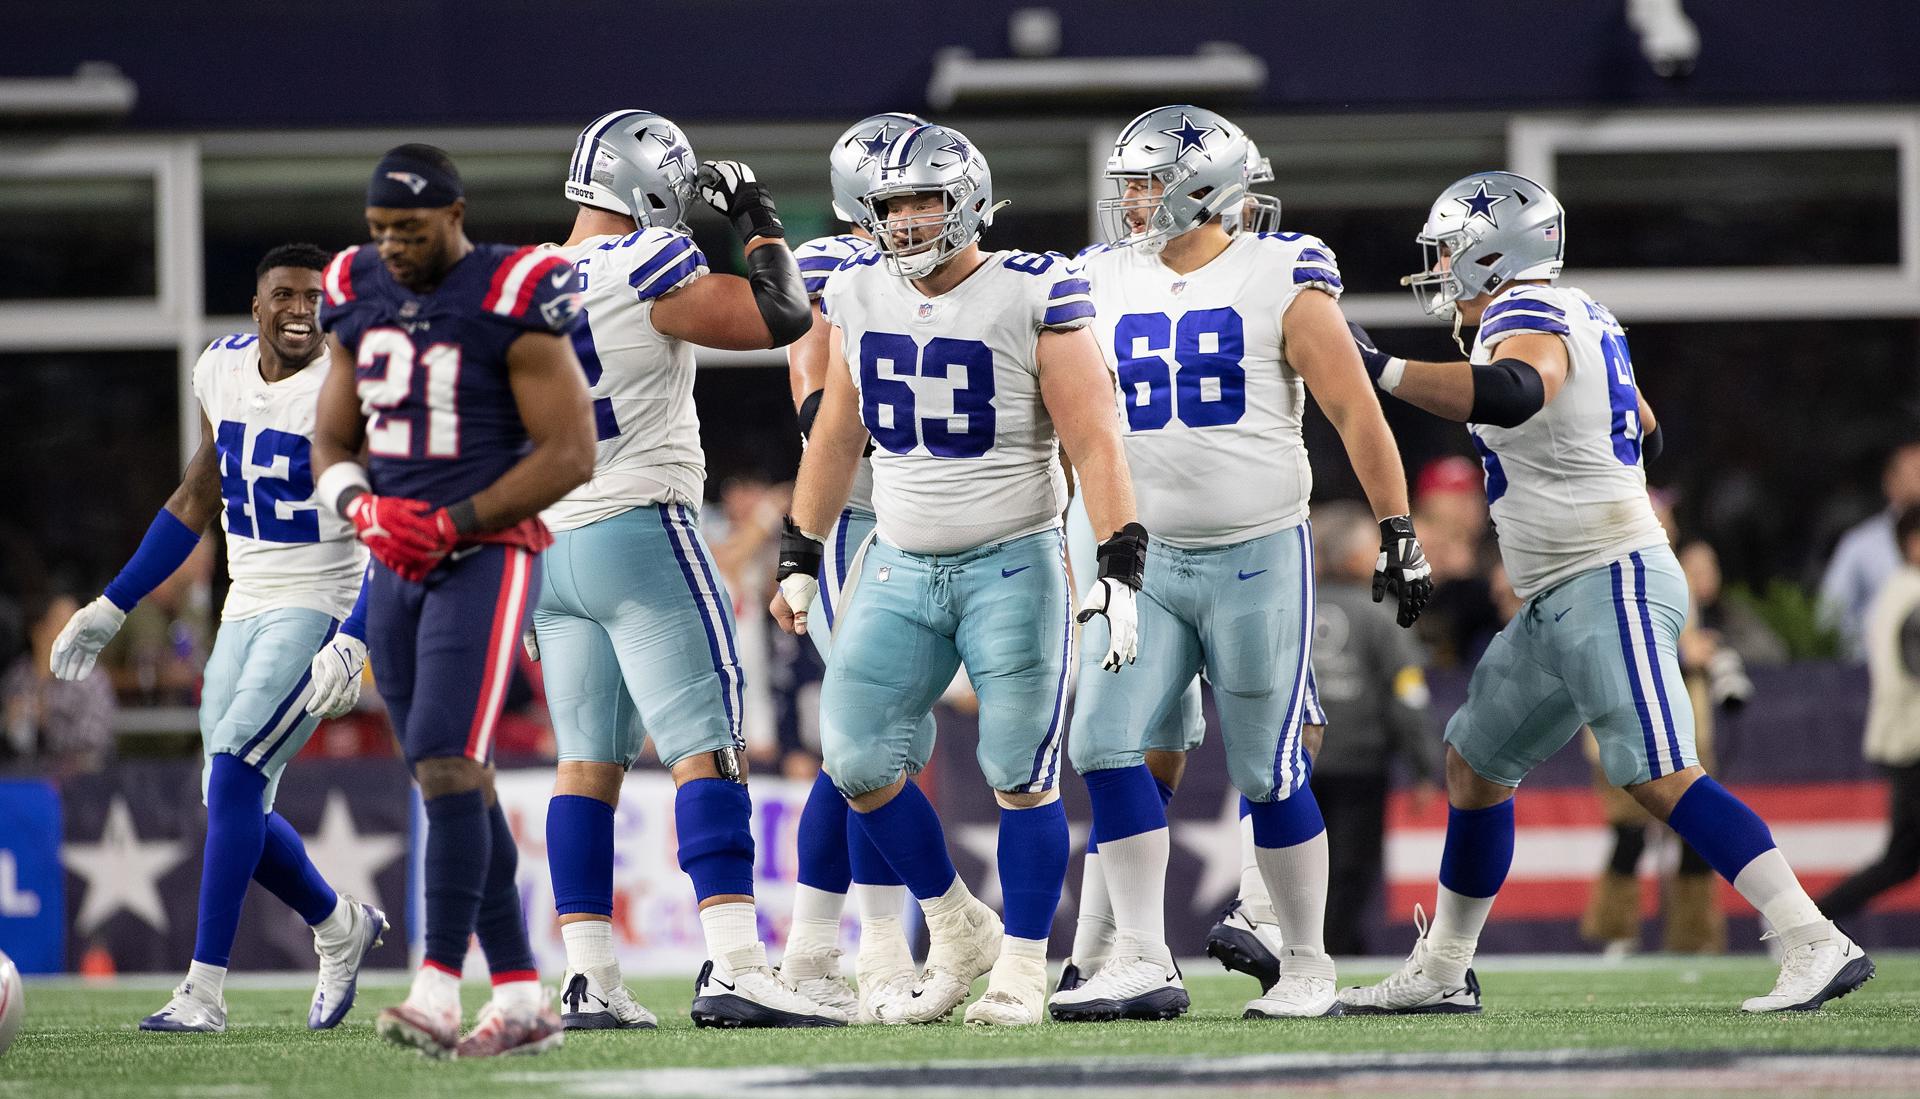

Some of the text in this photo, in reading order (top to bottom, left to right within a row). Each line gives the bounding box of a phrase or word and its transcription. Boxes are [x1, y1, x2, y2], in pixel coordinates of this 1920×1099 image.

[357, 326, 462, 459] 21
[859, 330, 996, 459] 63
[1114, 306, 1246, 432] 68
[215, 419, 321, 543] 42
